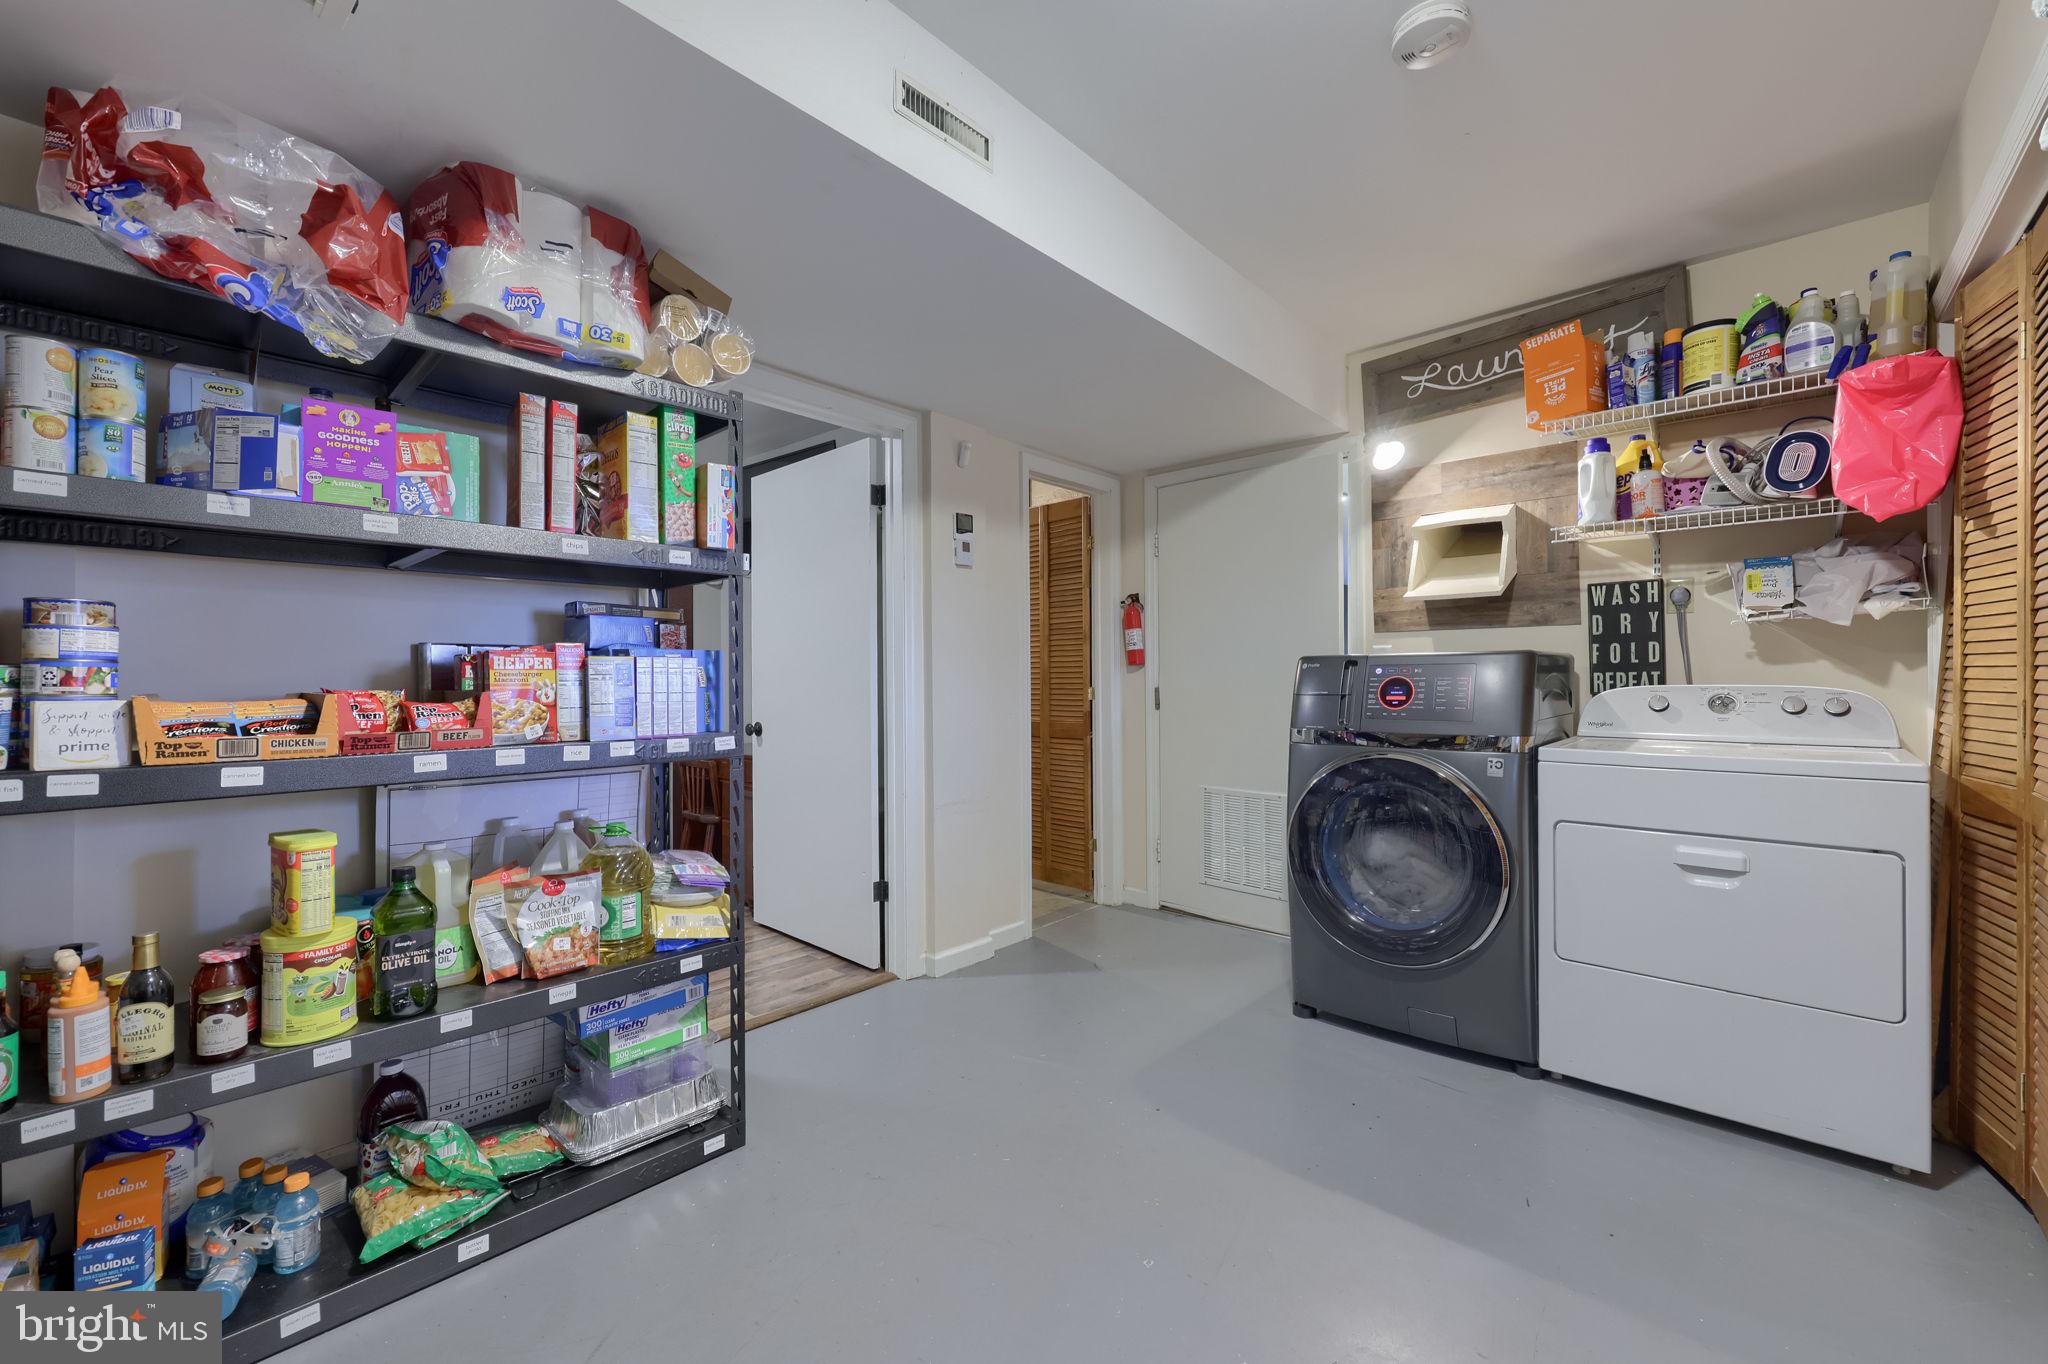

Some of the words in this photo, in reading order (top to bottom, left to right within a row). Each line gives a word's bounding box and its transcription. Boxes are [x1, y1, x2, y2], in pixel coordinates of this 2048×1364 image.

[506, 295, 541, 315] Scott
[589, 325, 613, 342] 30
[1525, 323, 1576, 351] SEPARATE
[93, 365, 114, 375] Pear
[91, 374, 118, 384] Slices
[208, 384, 240, 395] MOTT'S
[1544, 381, 1567, 396] PET
[666, 422, 694, 434] GLAZED
[565, 541, 584, 552] chips
[1591, 581, 1660, 607] WASH
[1592, 611, 1660, 636] DRY
[1592, 641, 1661, 665] FOLD
[493, 655, 553, 670] HELPER
[1593, 671, 1661, 693] REPEAT
[412, 704, 438, 715] Top
[415, 711, 462, 721] Ramen
[1587, 720, 1614, 729] Whirlpool
[350, 736, 372, 745] Top
[442, 731, 470, 741] BEEF
[58, 741, 110, 756] prime
[154, 741, 183, 753] Top
[270, 738, 314, 751] CHICKEN
[350, 743, 391, 752] Ramen
[154, 751, 206, 761] Ramen
[539, 908, 562, 920] STUFFING
[561, 907, 572, 915] MIX
[526, 918, 556, 932] SEASONED
[556, 911, 587, 926] VEGETABLE
[304, 946, 333, 960] FAMILY
[335, 943, 349, 953] SIZE
[381, 953, 405, 962] EXTRA
[405, 948, 430, 958] VIRGIN
[435, 945, 464, 957] ANOLA
[313, 953, 342, 964] CHOCOLATE
[381, 957, 412, 972] OLIVE
[413, 955, 430, 966] OIL
[437, 955, 452, 964] OIL
[552, 989, 575, 1002] vinegar
[588, 998, 625, 1017] Hefty
[585, 1019, 602, 1031] 300
[616, 1018, 647, 1034] Hefty
[511, 1077, 538, 1091] WED
[475, 1090, 501, 1102] THU
[438, 1101, 461, 1113] FRI
[96, 1184, 134, 1200] LIQUID
[93, 1220, 132, 1237] LIQUID
[85, 1236, 125, 1251] LIQUID
[77, 1270, 108, 1282] HYDRATION
[108, 1264, 140, 1275] MULTIPLIER
[82, 1259, 122, 1275] LIQUID
